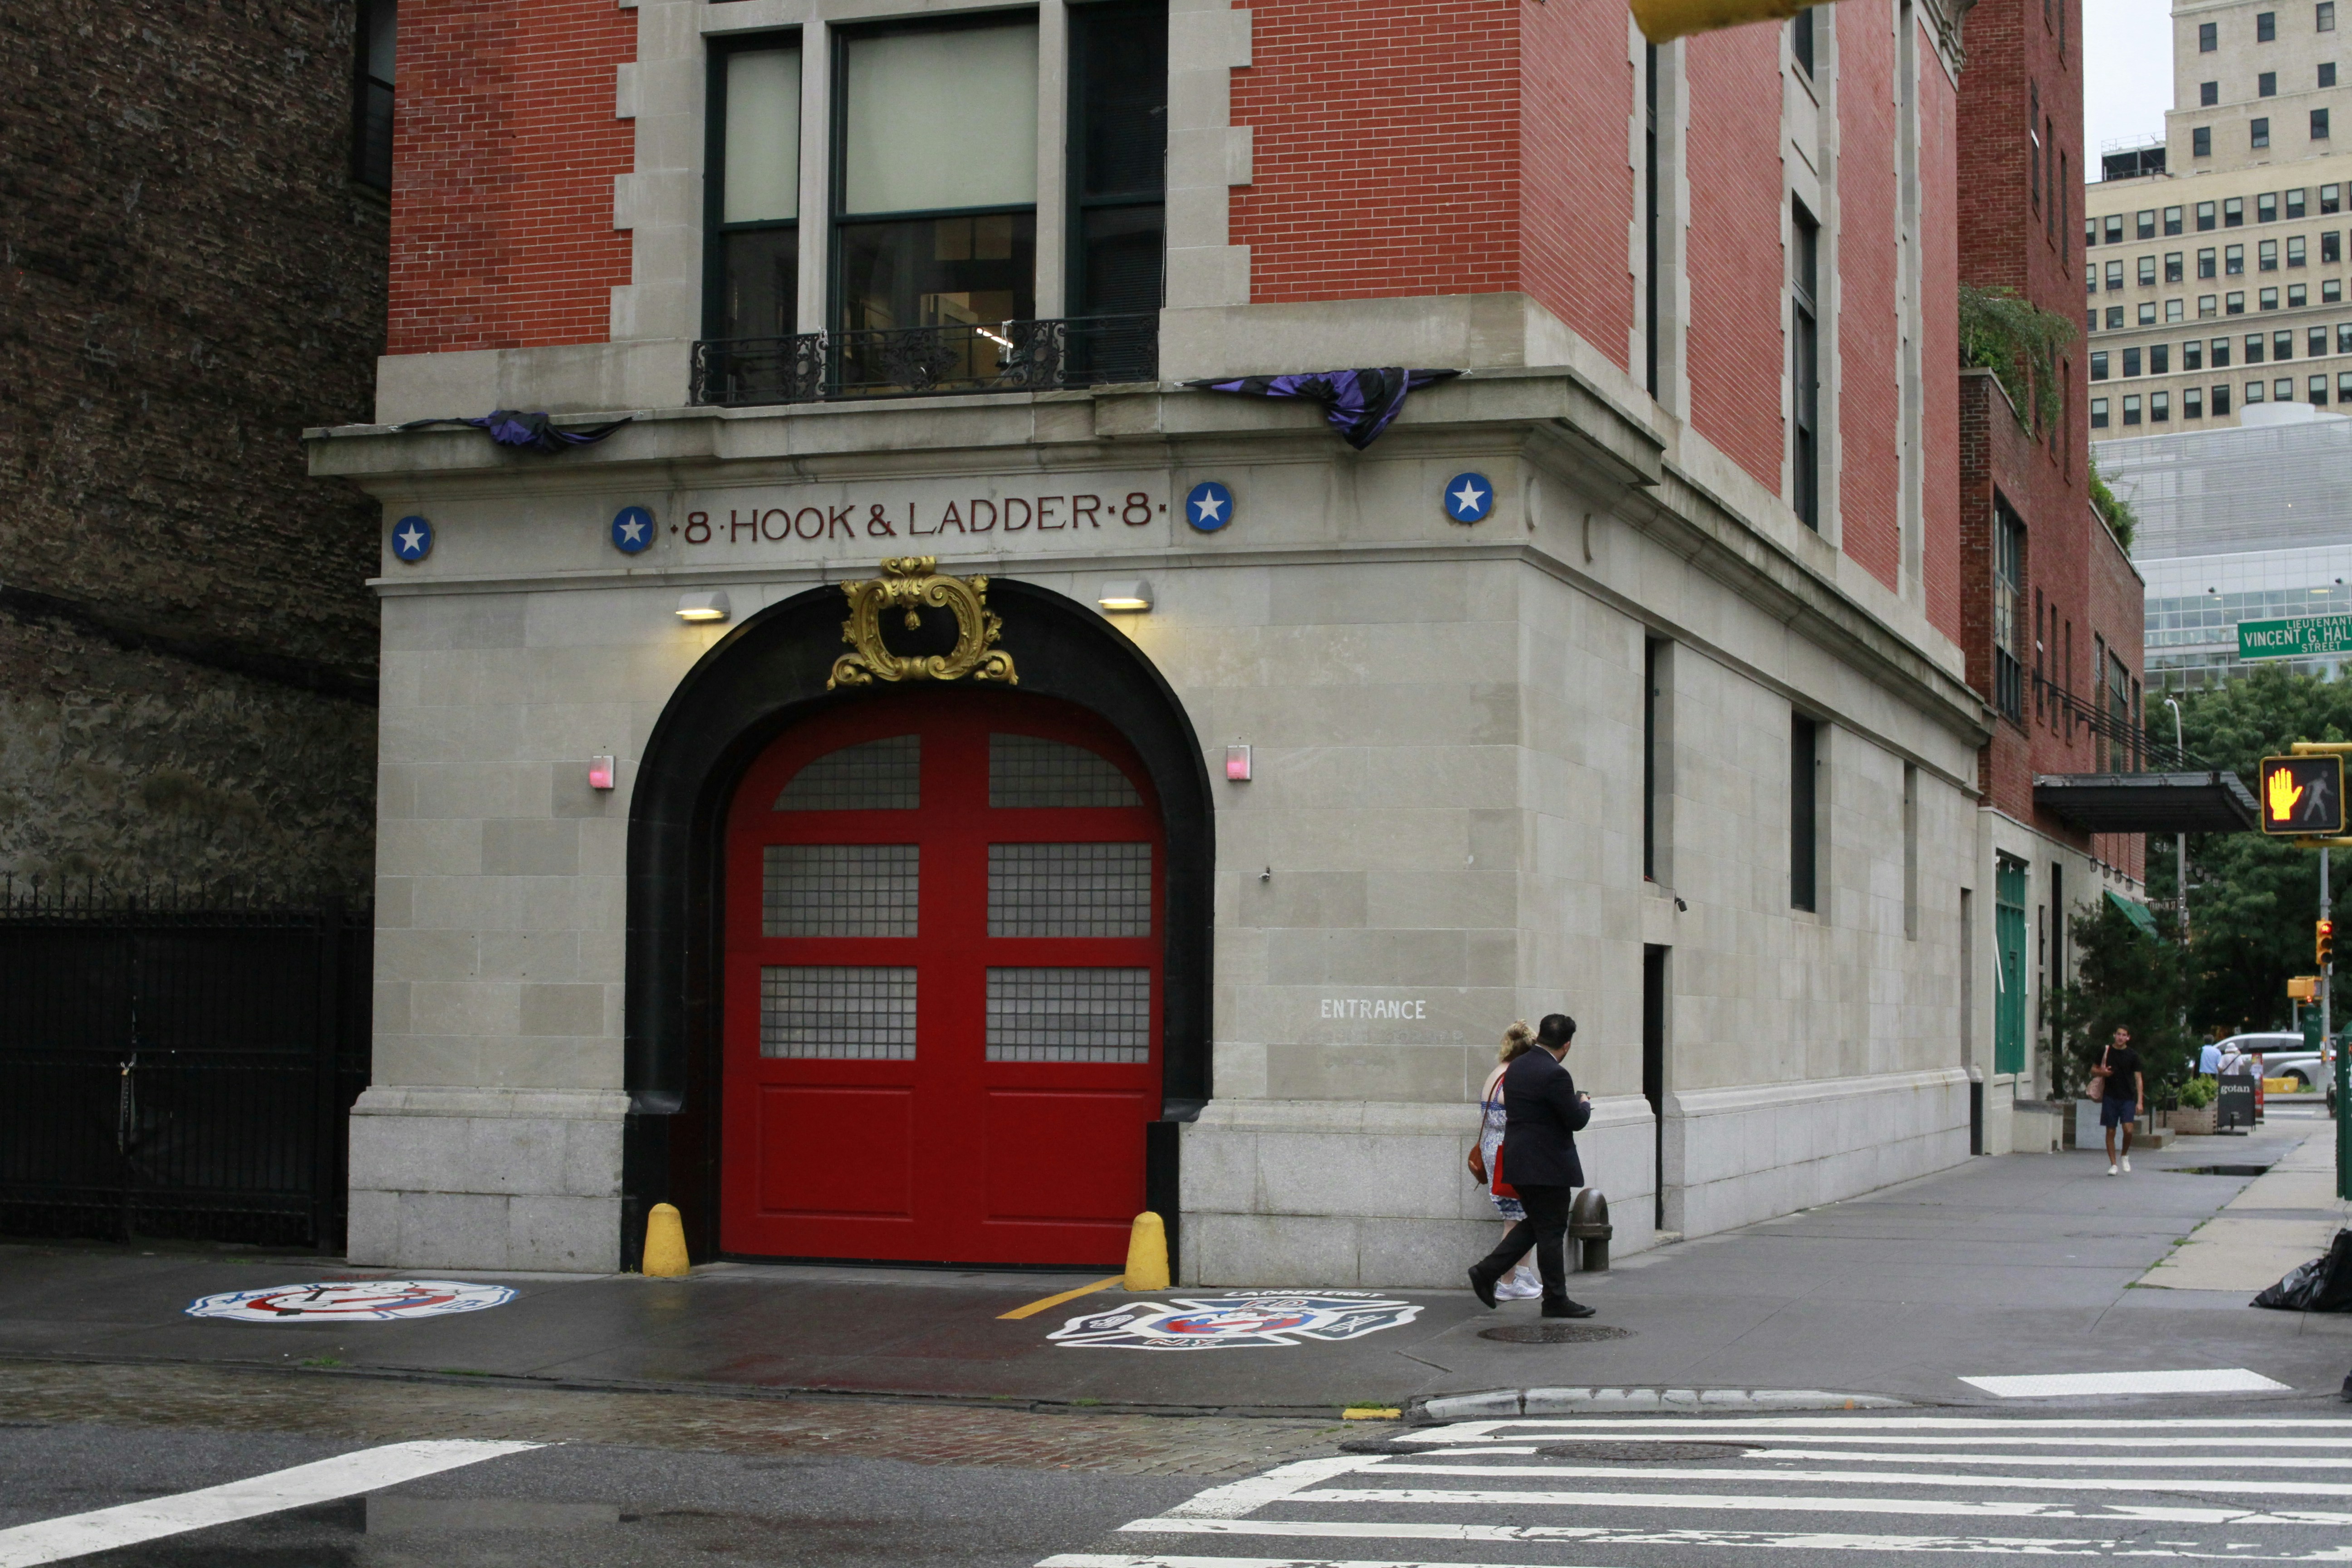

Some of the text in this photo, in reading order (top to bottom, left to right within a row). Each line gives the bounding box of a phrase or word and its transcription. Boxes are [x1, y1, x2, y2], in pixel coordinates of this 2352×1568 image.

[684, 492, 1152, 544] 8 HOOK & LADDER 8
[2286, 616, 2352, 630] LIEUTENANT
[2244, 626, 2352, 647] VINCENT G. HAL
[2301, 641, 2341, 653] STREET
[1321, 999, 1426, 1019] ENTRANCE
[2220, 1085, 2250, 1095] gotan
